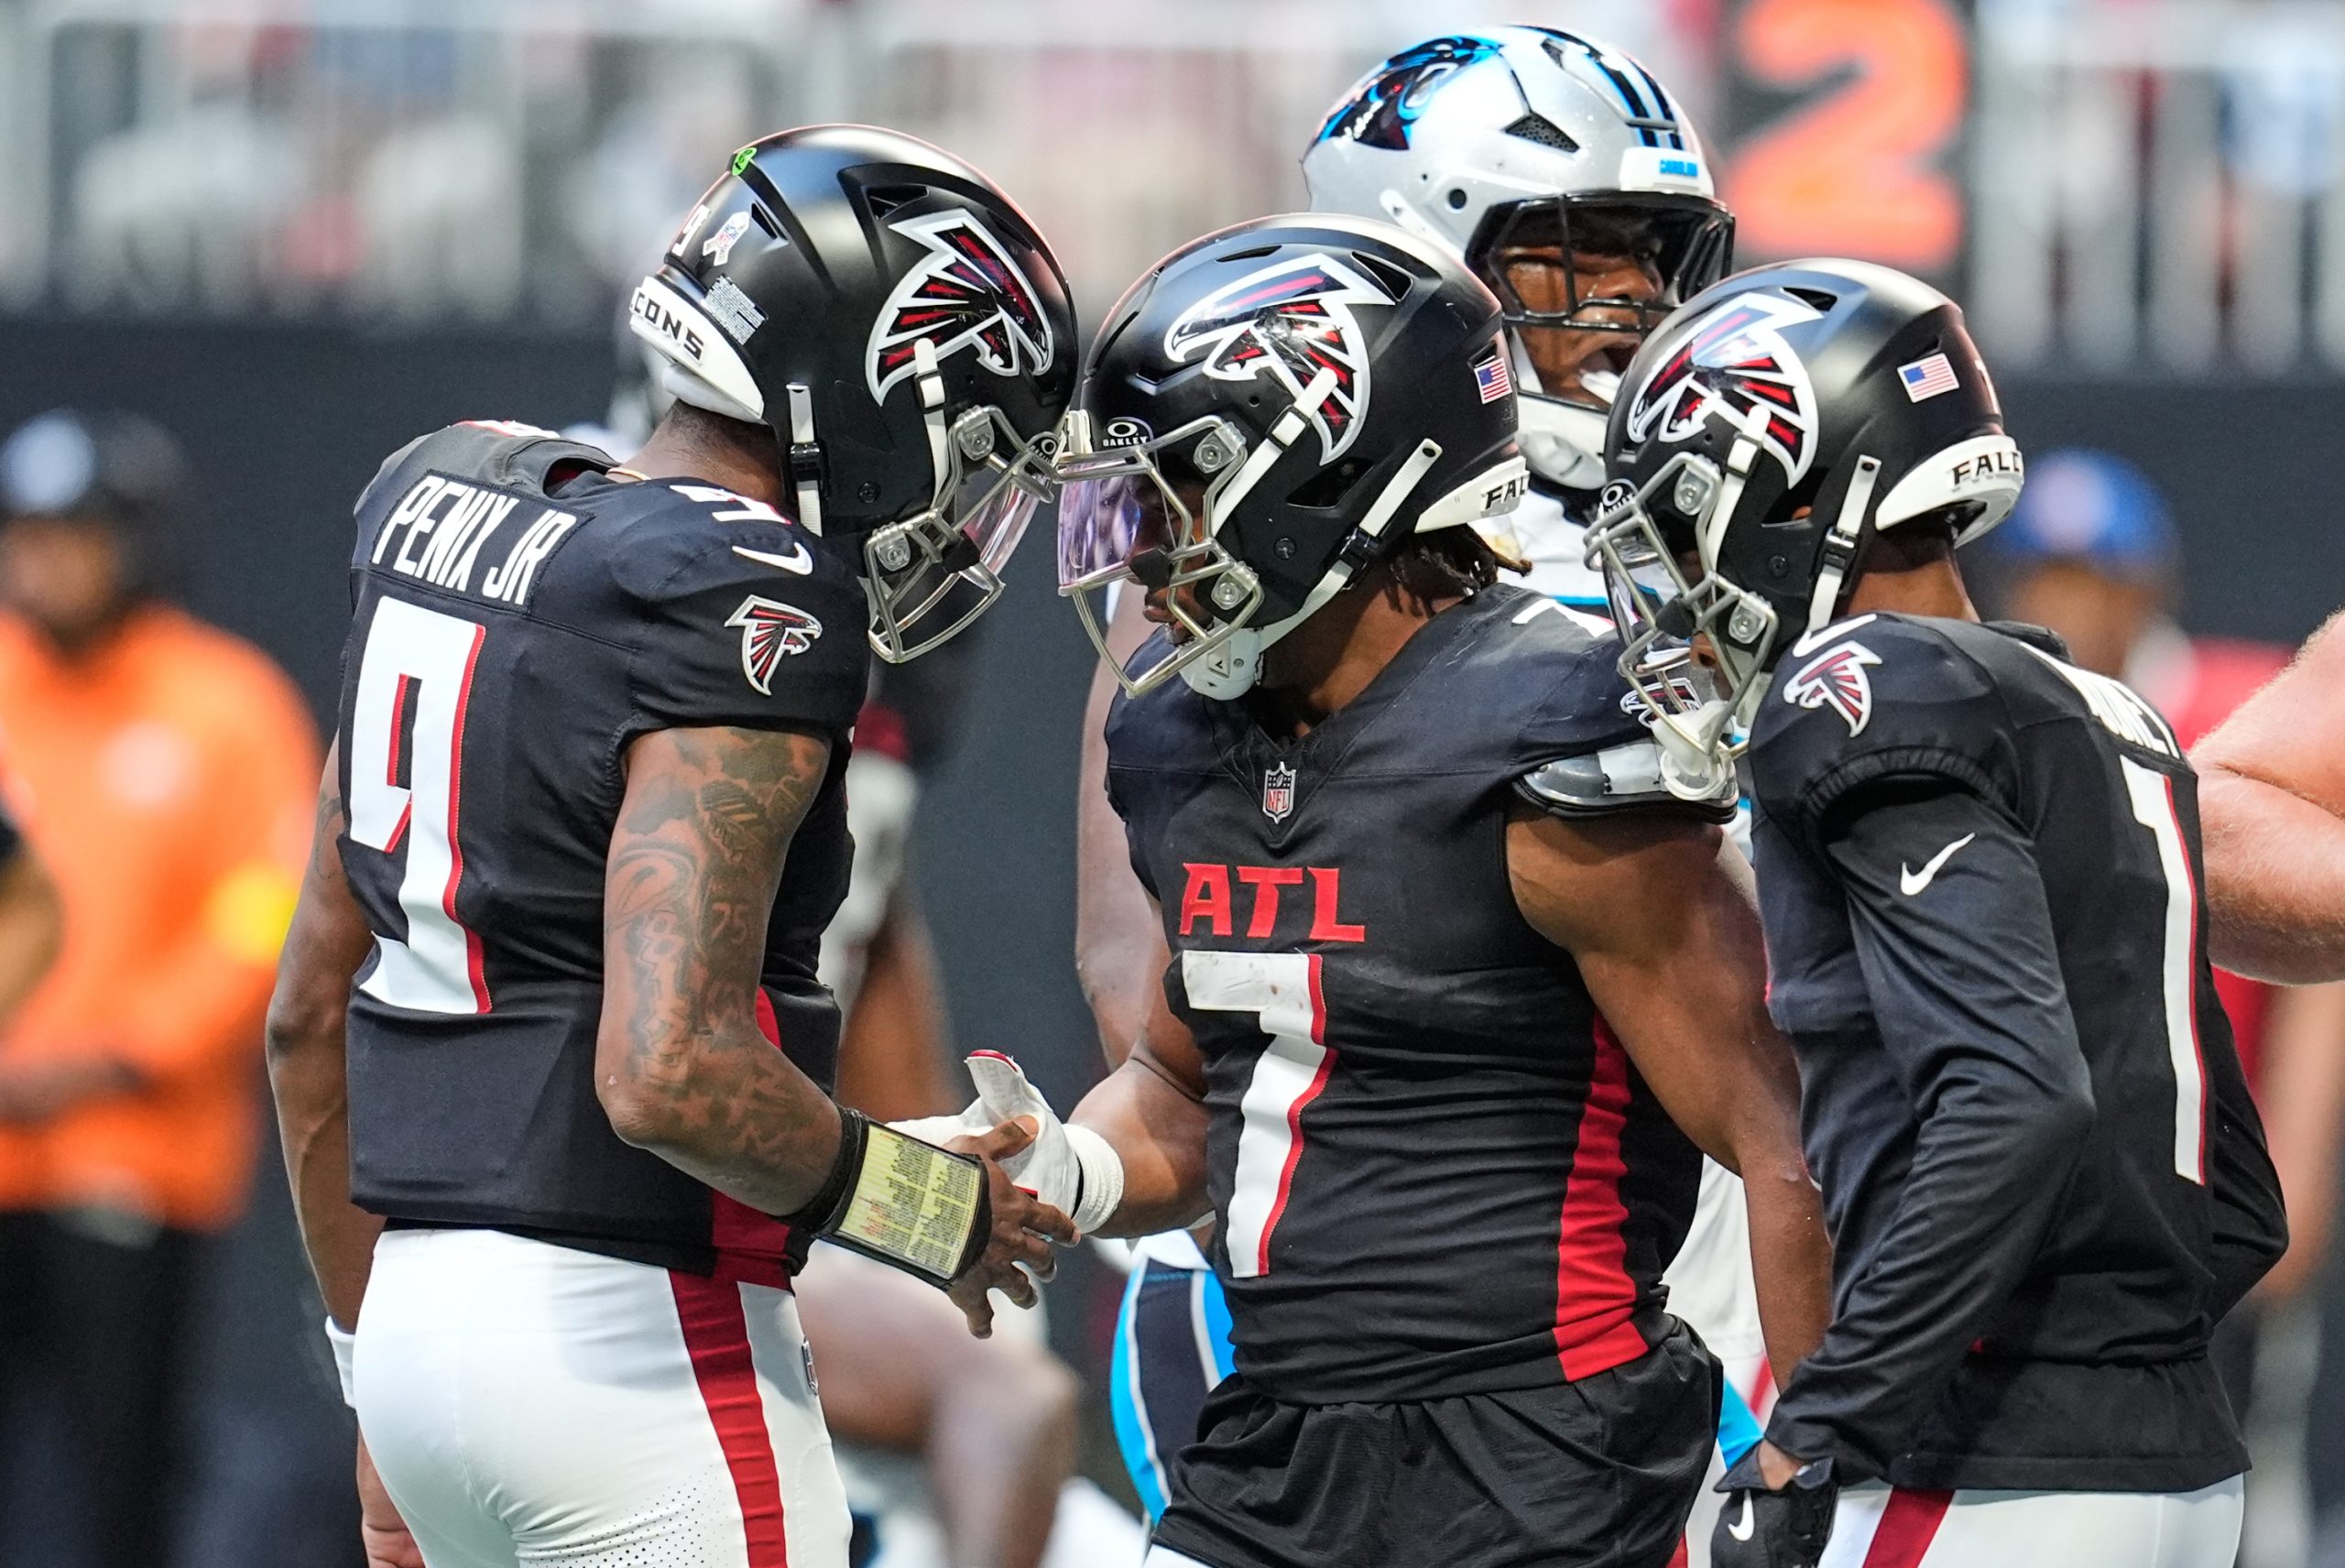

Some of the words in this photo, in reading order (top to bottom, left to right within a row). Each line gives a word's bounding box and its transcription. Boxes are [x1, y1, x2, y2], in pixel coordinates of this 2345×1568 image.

[1102, 436, 1149, 447] OAKLEY
[371, 474, 520, 593] PENIX
[482, 508, 577, 606] JR
[348, 594, 493, 1015] 9
[1268, 790, 1288, 812] NFL
[1179, 862, 1367, 943] ATL
[2119, 753, 2207, 1187] 1
[1181, 950, 1339, 1279] 7
